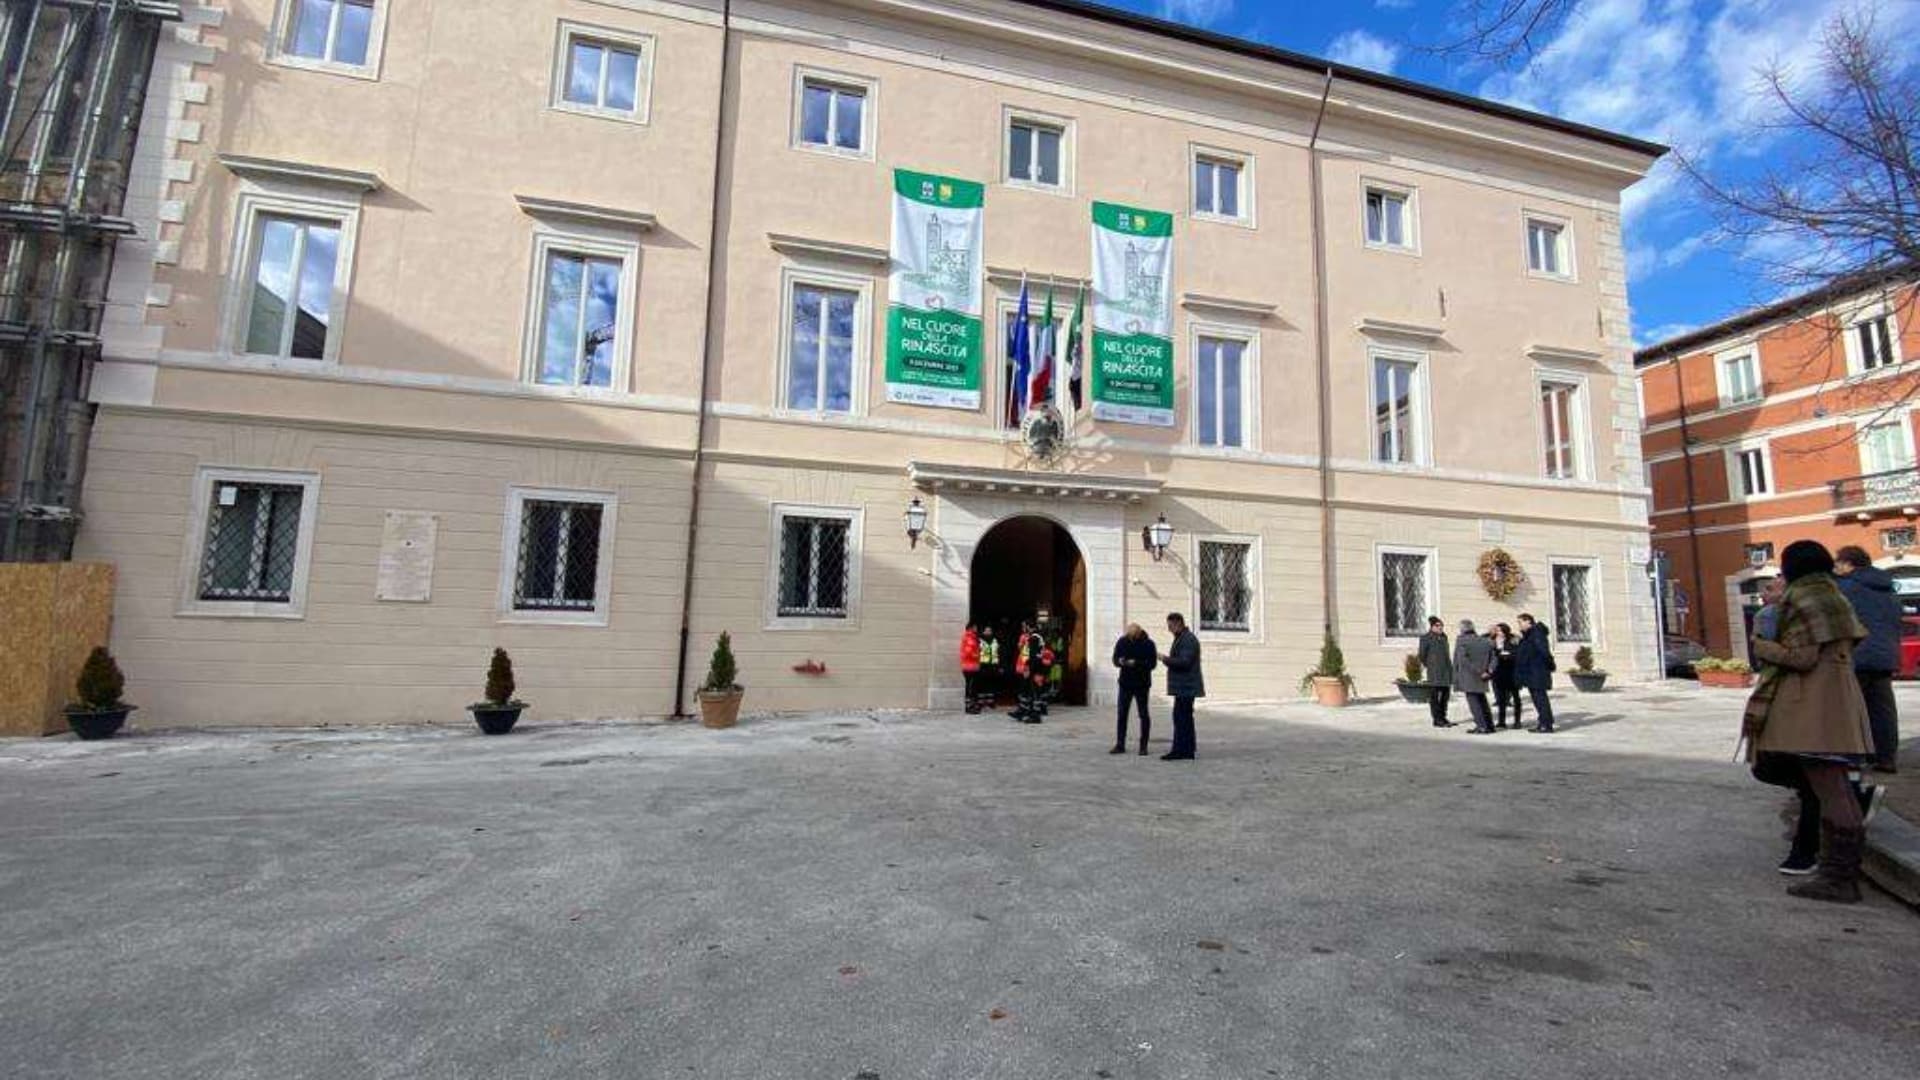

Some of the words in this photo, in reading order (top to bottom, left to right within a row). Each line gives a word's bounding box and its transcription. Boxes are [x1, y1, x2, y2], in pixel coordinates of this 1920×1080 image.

[902, 317, 924, 331] NEL
[926, 321, 967, 337] CUORE
[921, 331, 948, 343] DELLA
[901, 338, 967, 358] RINASCITA
[1103, 340, 1123, 353] NEL
[1124, 343, 1163, 359] CUORE
[1120, 353, 1145, 365] DELLA
[1102, 361, 1163, 378] RINASCITA
